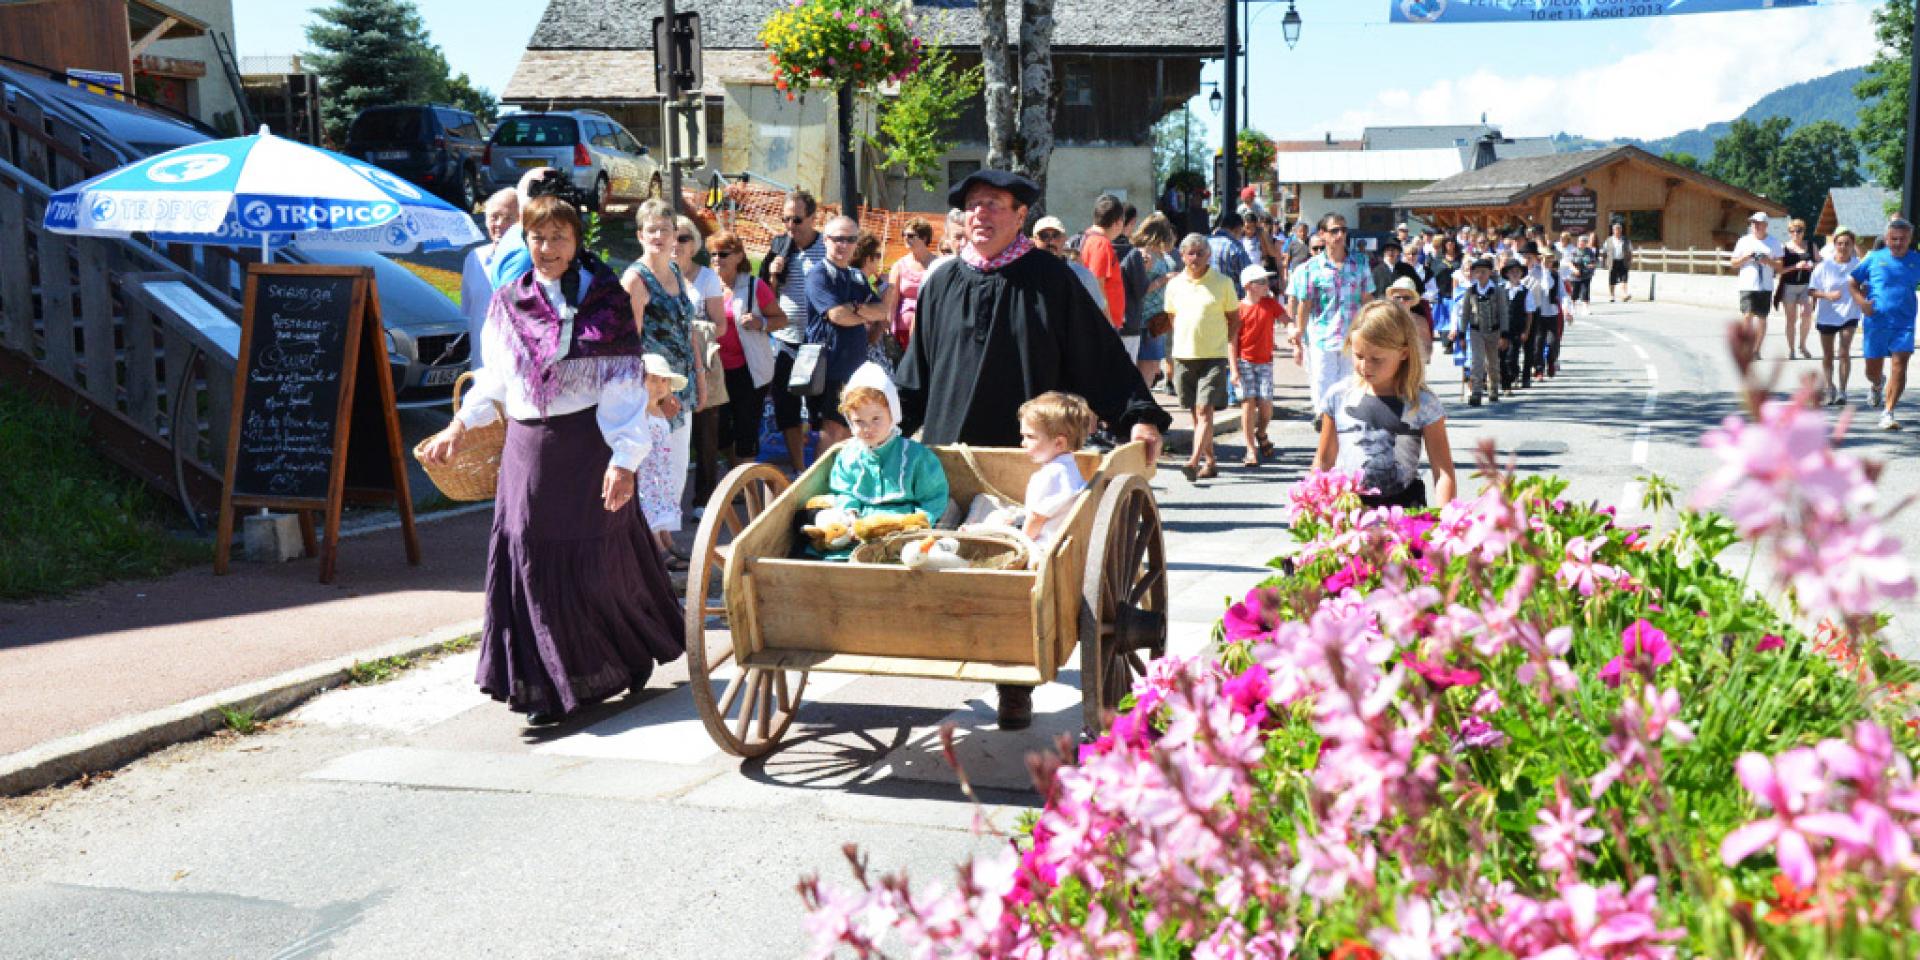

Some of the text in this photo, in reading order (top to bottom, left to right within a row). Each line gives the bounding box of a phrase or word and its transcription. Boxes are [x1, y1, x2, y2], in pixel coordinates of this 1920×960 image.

[1530, 4, 1663, 20] 10 et 11 Août 2013
[276, 203, 393, 224] TROPICO
